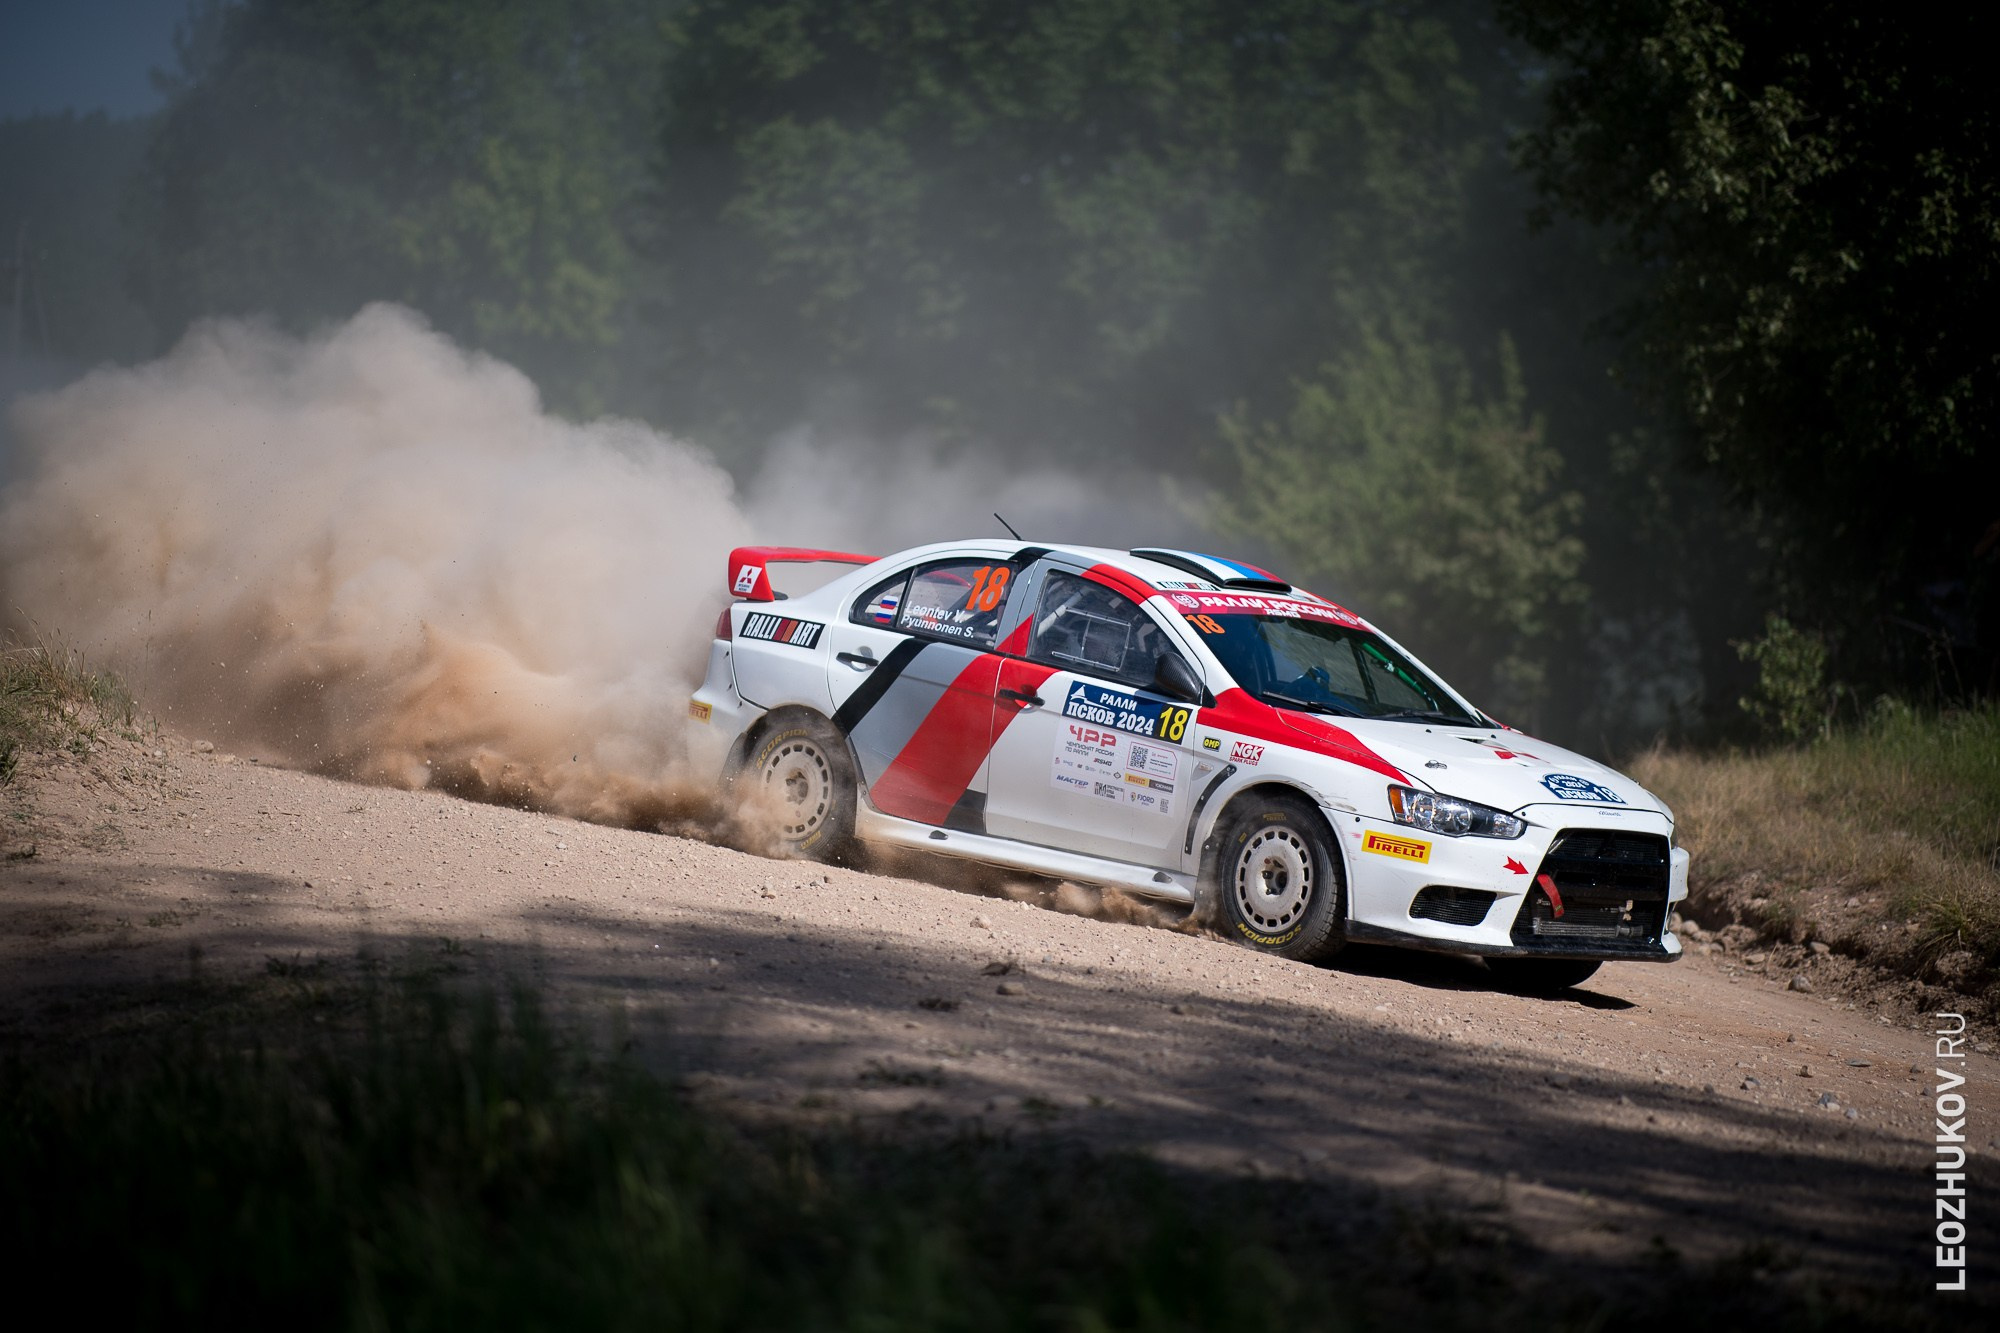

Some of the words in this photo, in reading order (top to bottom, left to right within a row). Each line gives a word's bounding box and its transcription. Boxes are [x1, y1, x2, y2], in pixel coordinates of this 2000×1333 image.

[966, 566, 1010, 612] 18
[905, 601, 953, 621] Leontev
[1198, 596, 1269, 608] РАЛЛИ
[743, 613, 783, 640] RALLI
[789, 621, 821, 647] ART
[901, 615, 963, 636] Pyunnonen
[963, 626, 975, 638] S.
[1185, 614, 1225, 634] 18
[1100, 692, 1138, 711] РАЛЛИ
[1066, 701, 1116, 726] ПСКОВ
[1116, 711, 1155, 736] 2024
[1159, 706, 1189, 741] 18
[1066, 740, 1095, 752] ЧЕМПИОНАТ
[1094, 747, 1115, 757] РОССИИ
[1203, 738, 1220, 749] OMP
[1231, 741, 1264, 761] NGK
[1243, 759, 1259, 767] PLUGS
[1056, 774, 1089, 786] МАСТЕР
[1136, 793, 1155, 804] FJORD
[1592, 786, 1624, 803] 18
[1367, 835, 1426, 859] PIRELLI
[1237, 922, 1302, 945] SCORPION
